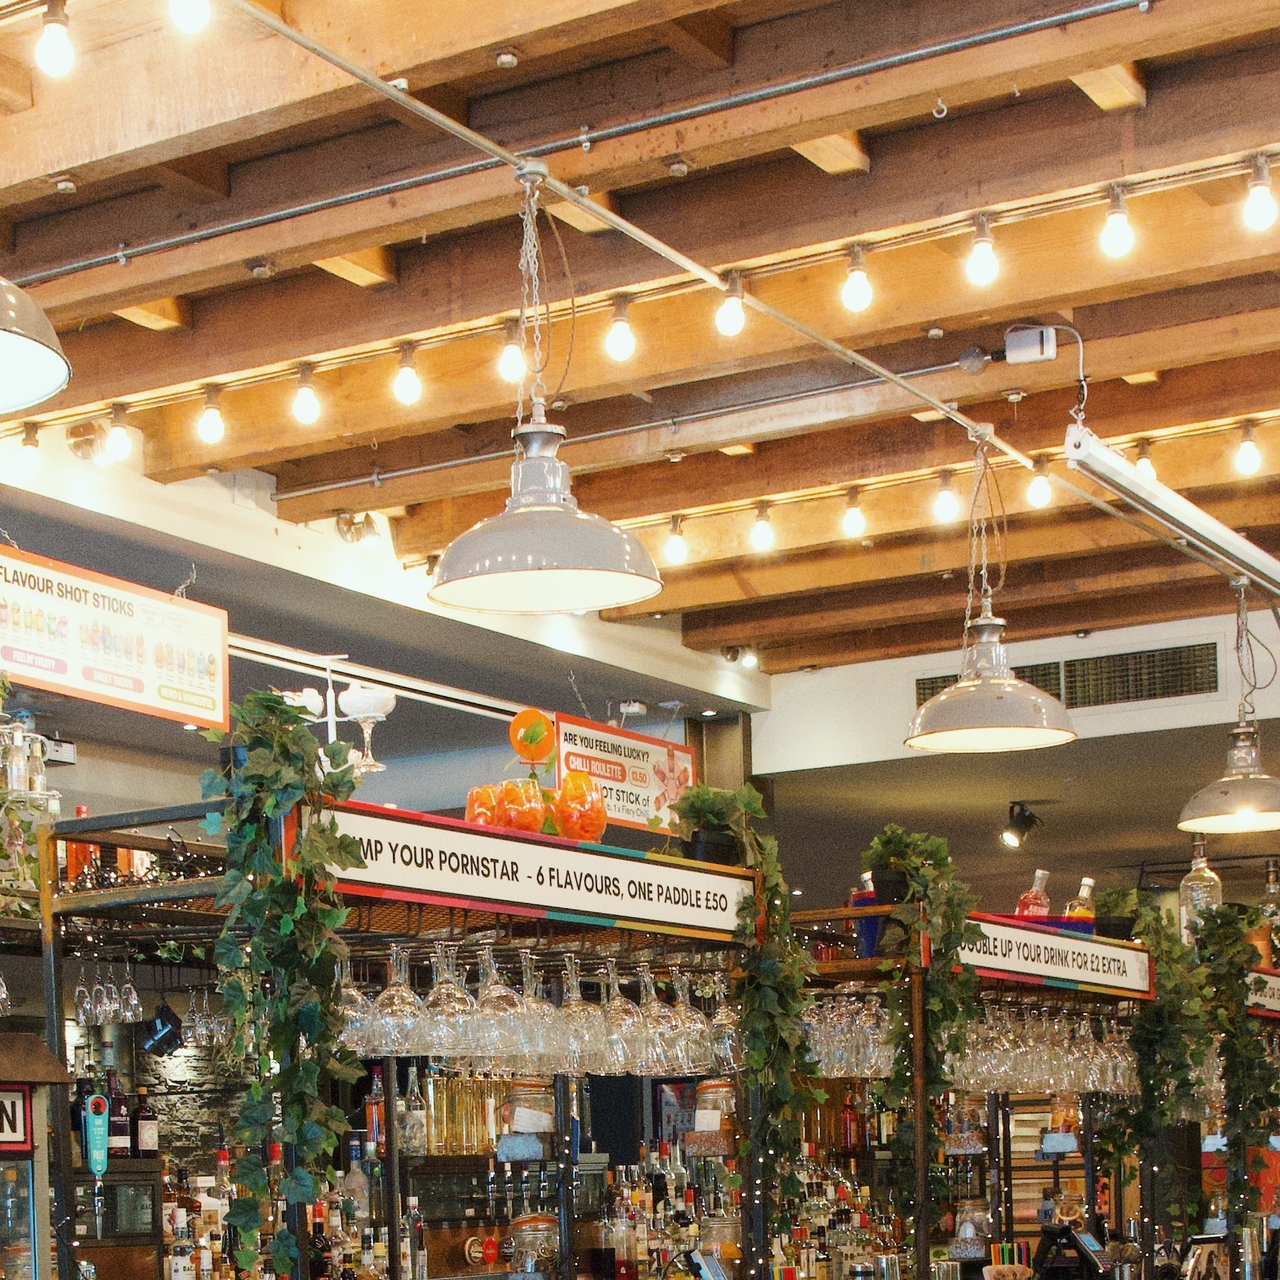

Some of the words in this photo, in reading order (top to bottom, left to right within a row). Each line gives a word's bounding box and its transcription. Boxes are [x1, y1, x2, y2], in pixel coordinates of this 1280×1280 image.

[56, 582, 90, 606] SHOT
[92, 593, 135, 618] STICKS
[563, 732, 577, 746] ARE
[578, 735, 594, 750] YOU
[595, 740, 623, 756] FEELING
[623, 746, 650, 763] LUCKY?
[569, 755, 590, 771] CHILLI
[590, 760, 622, 780] ROULETTE
[602, 786, 614, 800] OT
[615, 788, 641, 806] STICK
[642, 795, 650, 807] of
[359, 837, 383, 862] MP
[387, 841, 435, 870] YOUR
[439, 848, 520, 883] PORNSTAR
[536, 865, 545, 886] 6
[548, 867, 625, 902] FLAVOURS,
[627, 879, 653, 902] ONE
[656, 884, 702, 911] PADDLE
[704, 890, 729, 913] £50
[1000, 941, 1014, 959] UP
[1015, 942, 1043, 964] YOUR
[1043, 946, 1071, 969] DRINK
[1071, 951, 1088, 972] FOR
[1090, 956, 1100, 973] £2
[1101, 956, 1128, 977] EXTRA
